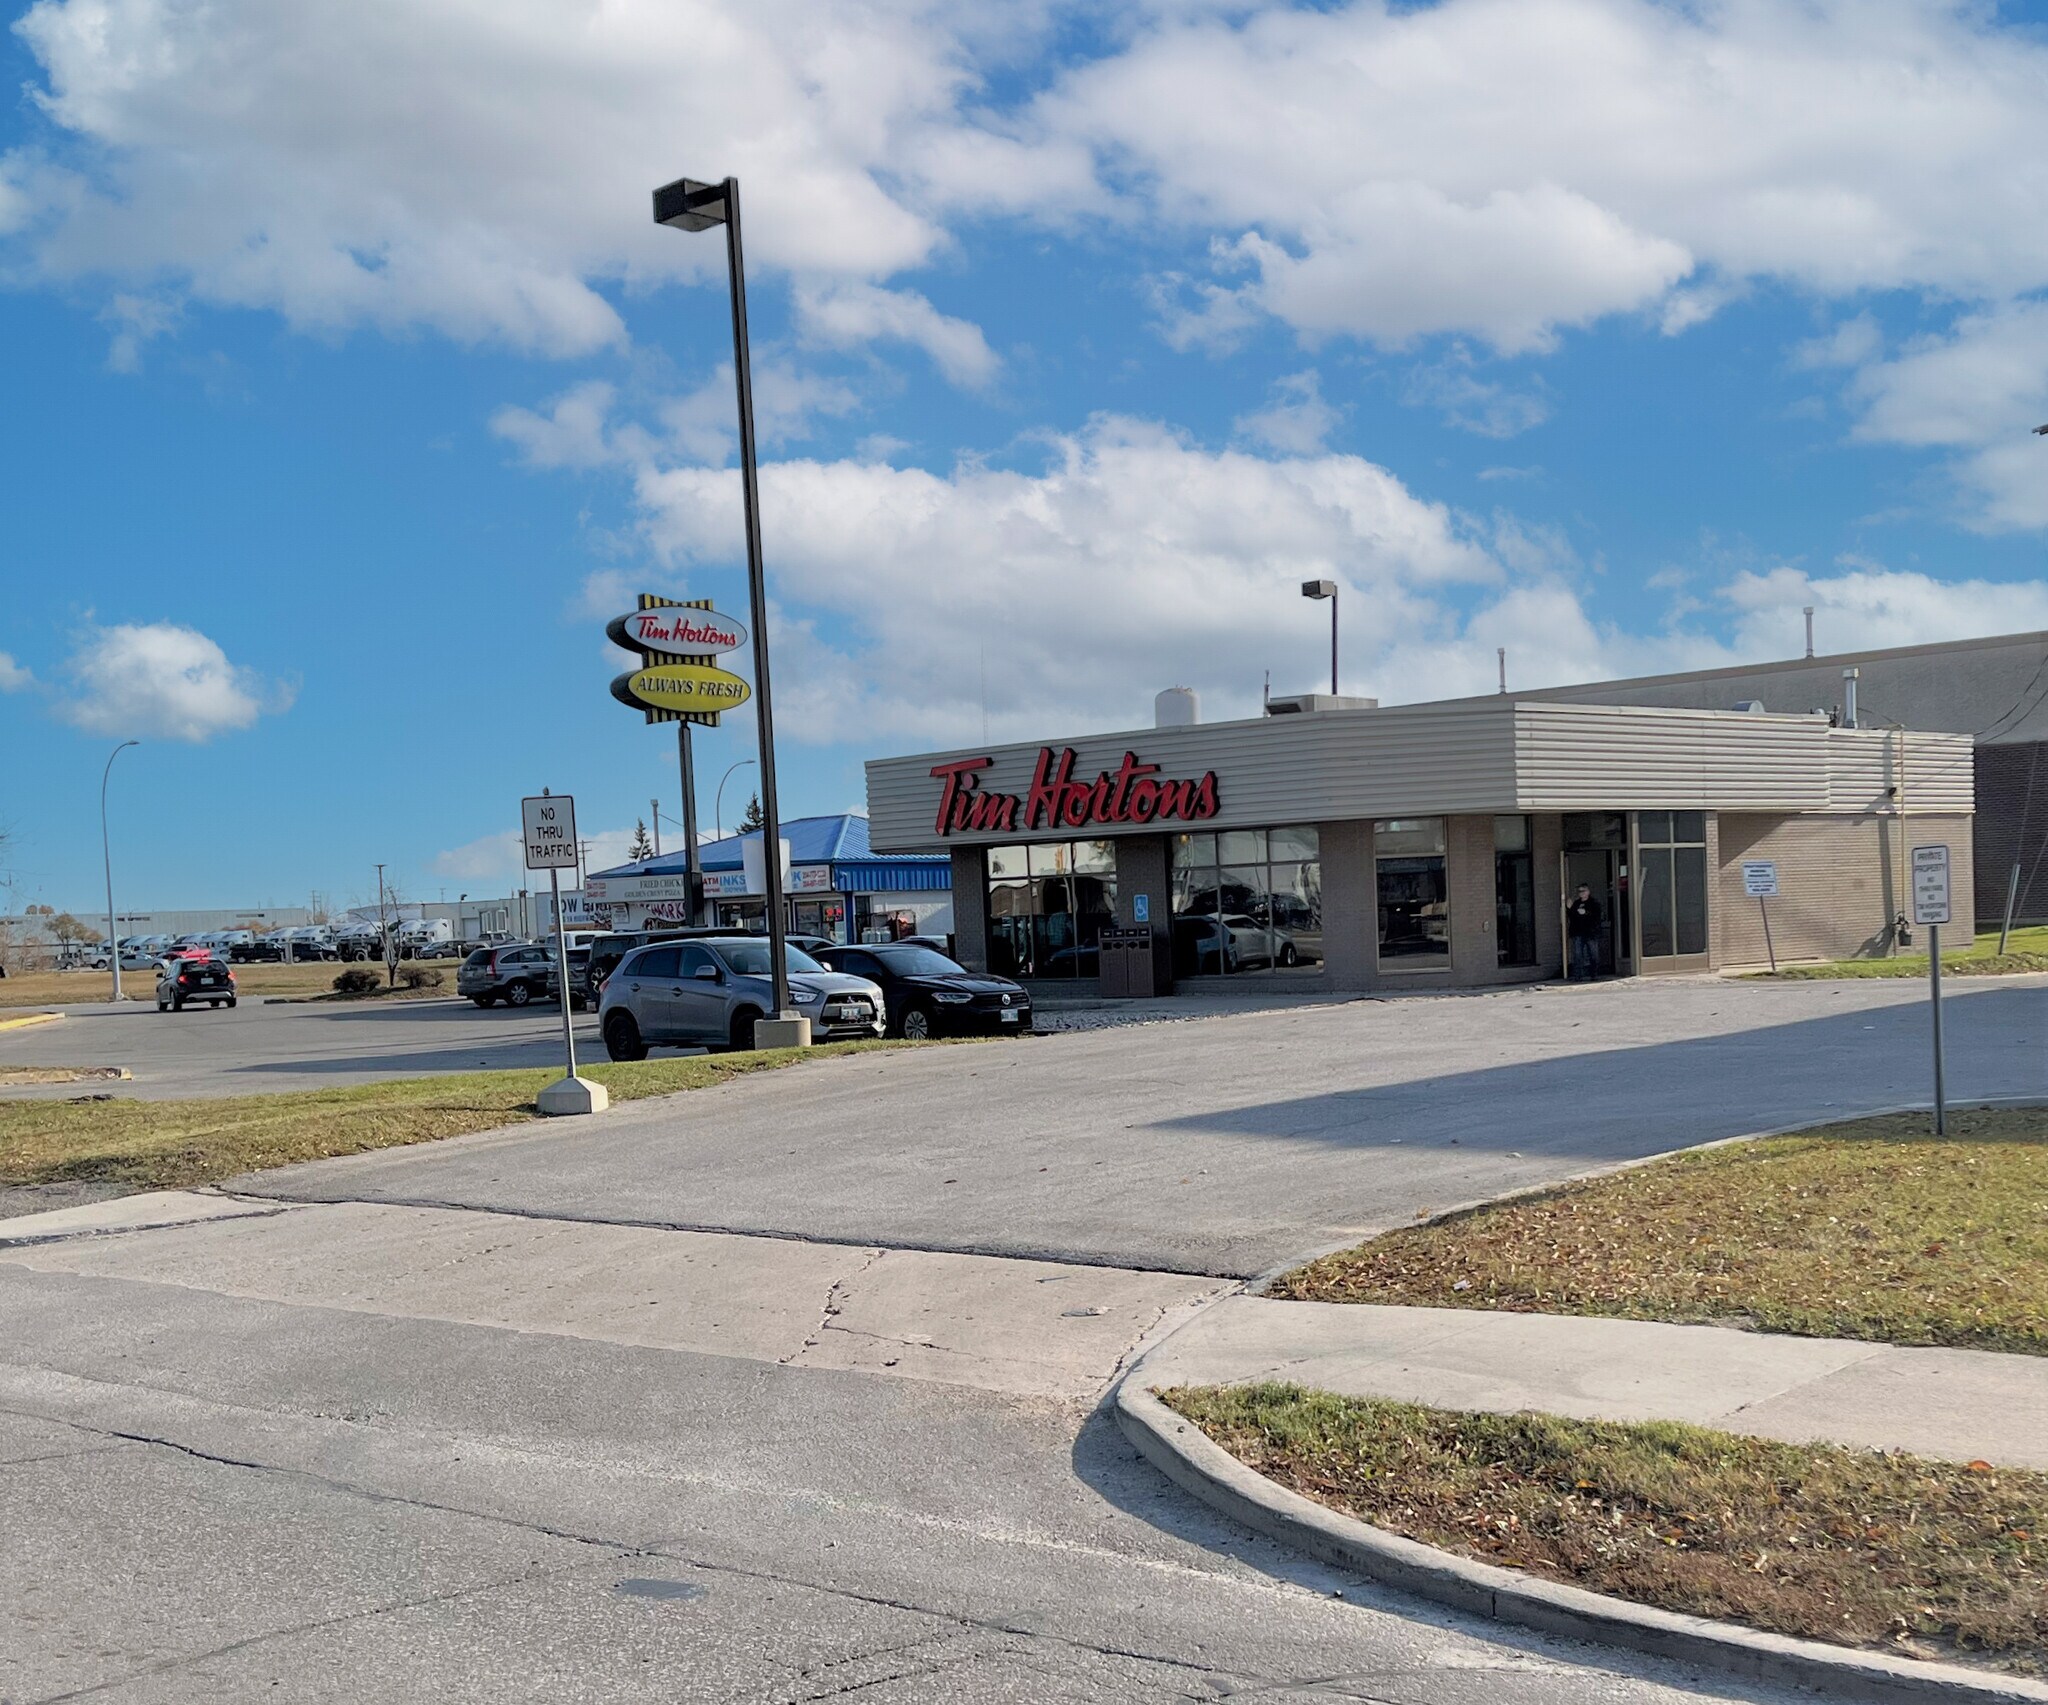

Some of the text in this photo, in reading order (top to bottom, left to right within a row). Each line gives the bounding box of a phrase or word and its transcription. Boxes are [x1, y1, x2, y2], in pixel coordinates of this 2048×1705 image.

[637, 616, 736, 647] Tim Hortons
[636, 675, 744, 698] ALWAYS FRESH
[929, 747, 1221, 837] Tim Hortons
[540, 807, 555, 821] NO
[536, 826, 563, 840] THRU
[529, 843, 573, 859] TRAFFIC
